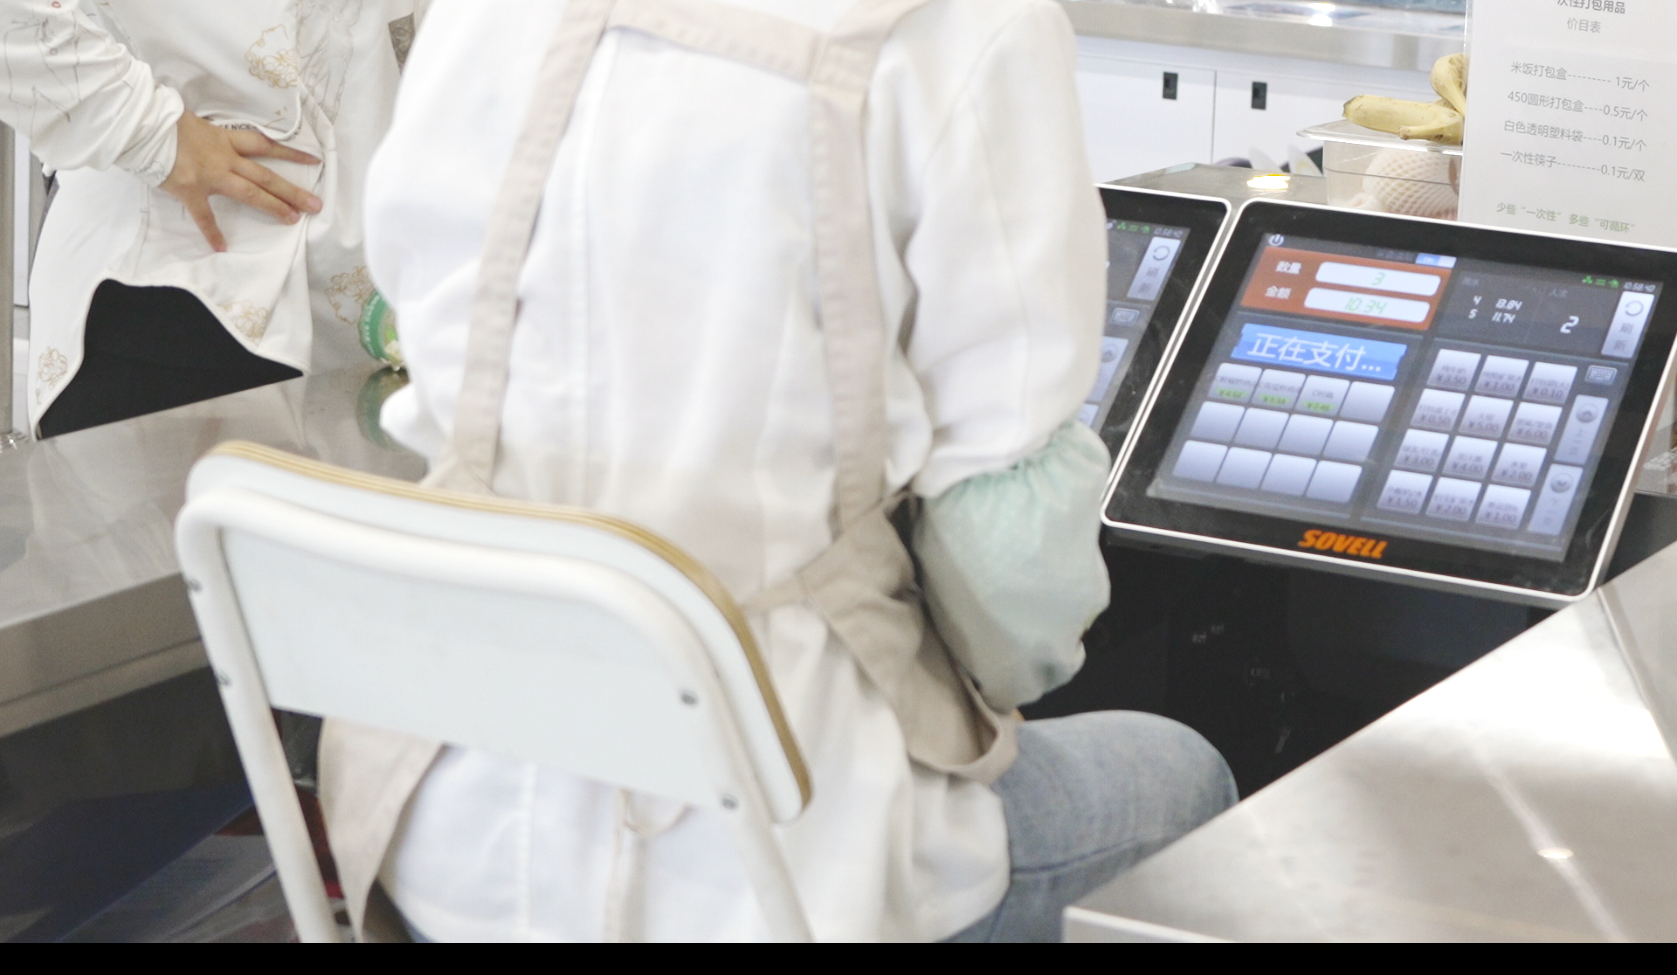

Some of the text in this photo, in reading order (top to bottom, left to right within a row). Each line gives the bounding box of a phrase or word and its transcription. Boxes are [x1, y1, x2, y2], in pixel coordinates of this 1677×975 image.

[1566, 17, 1601, 34] 价目表
[1275, 260, 1302, 275] 数量
[1372, 272, 1385, 286] 3
[1264, 285, 1292, 300] 金额
[1344, 296, 1388, 315] 10.34
[1560, 315, 1579, 334] 2
[1297, 528, 1388, 559] SOVELL
